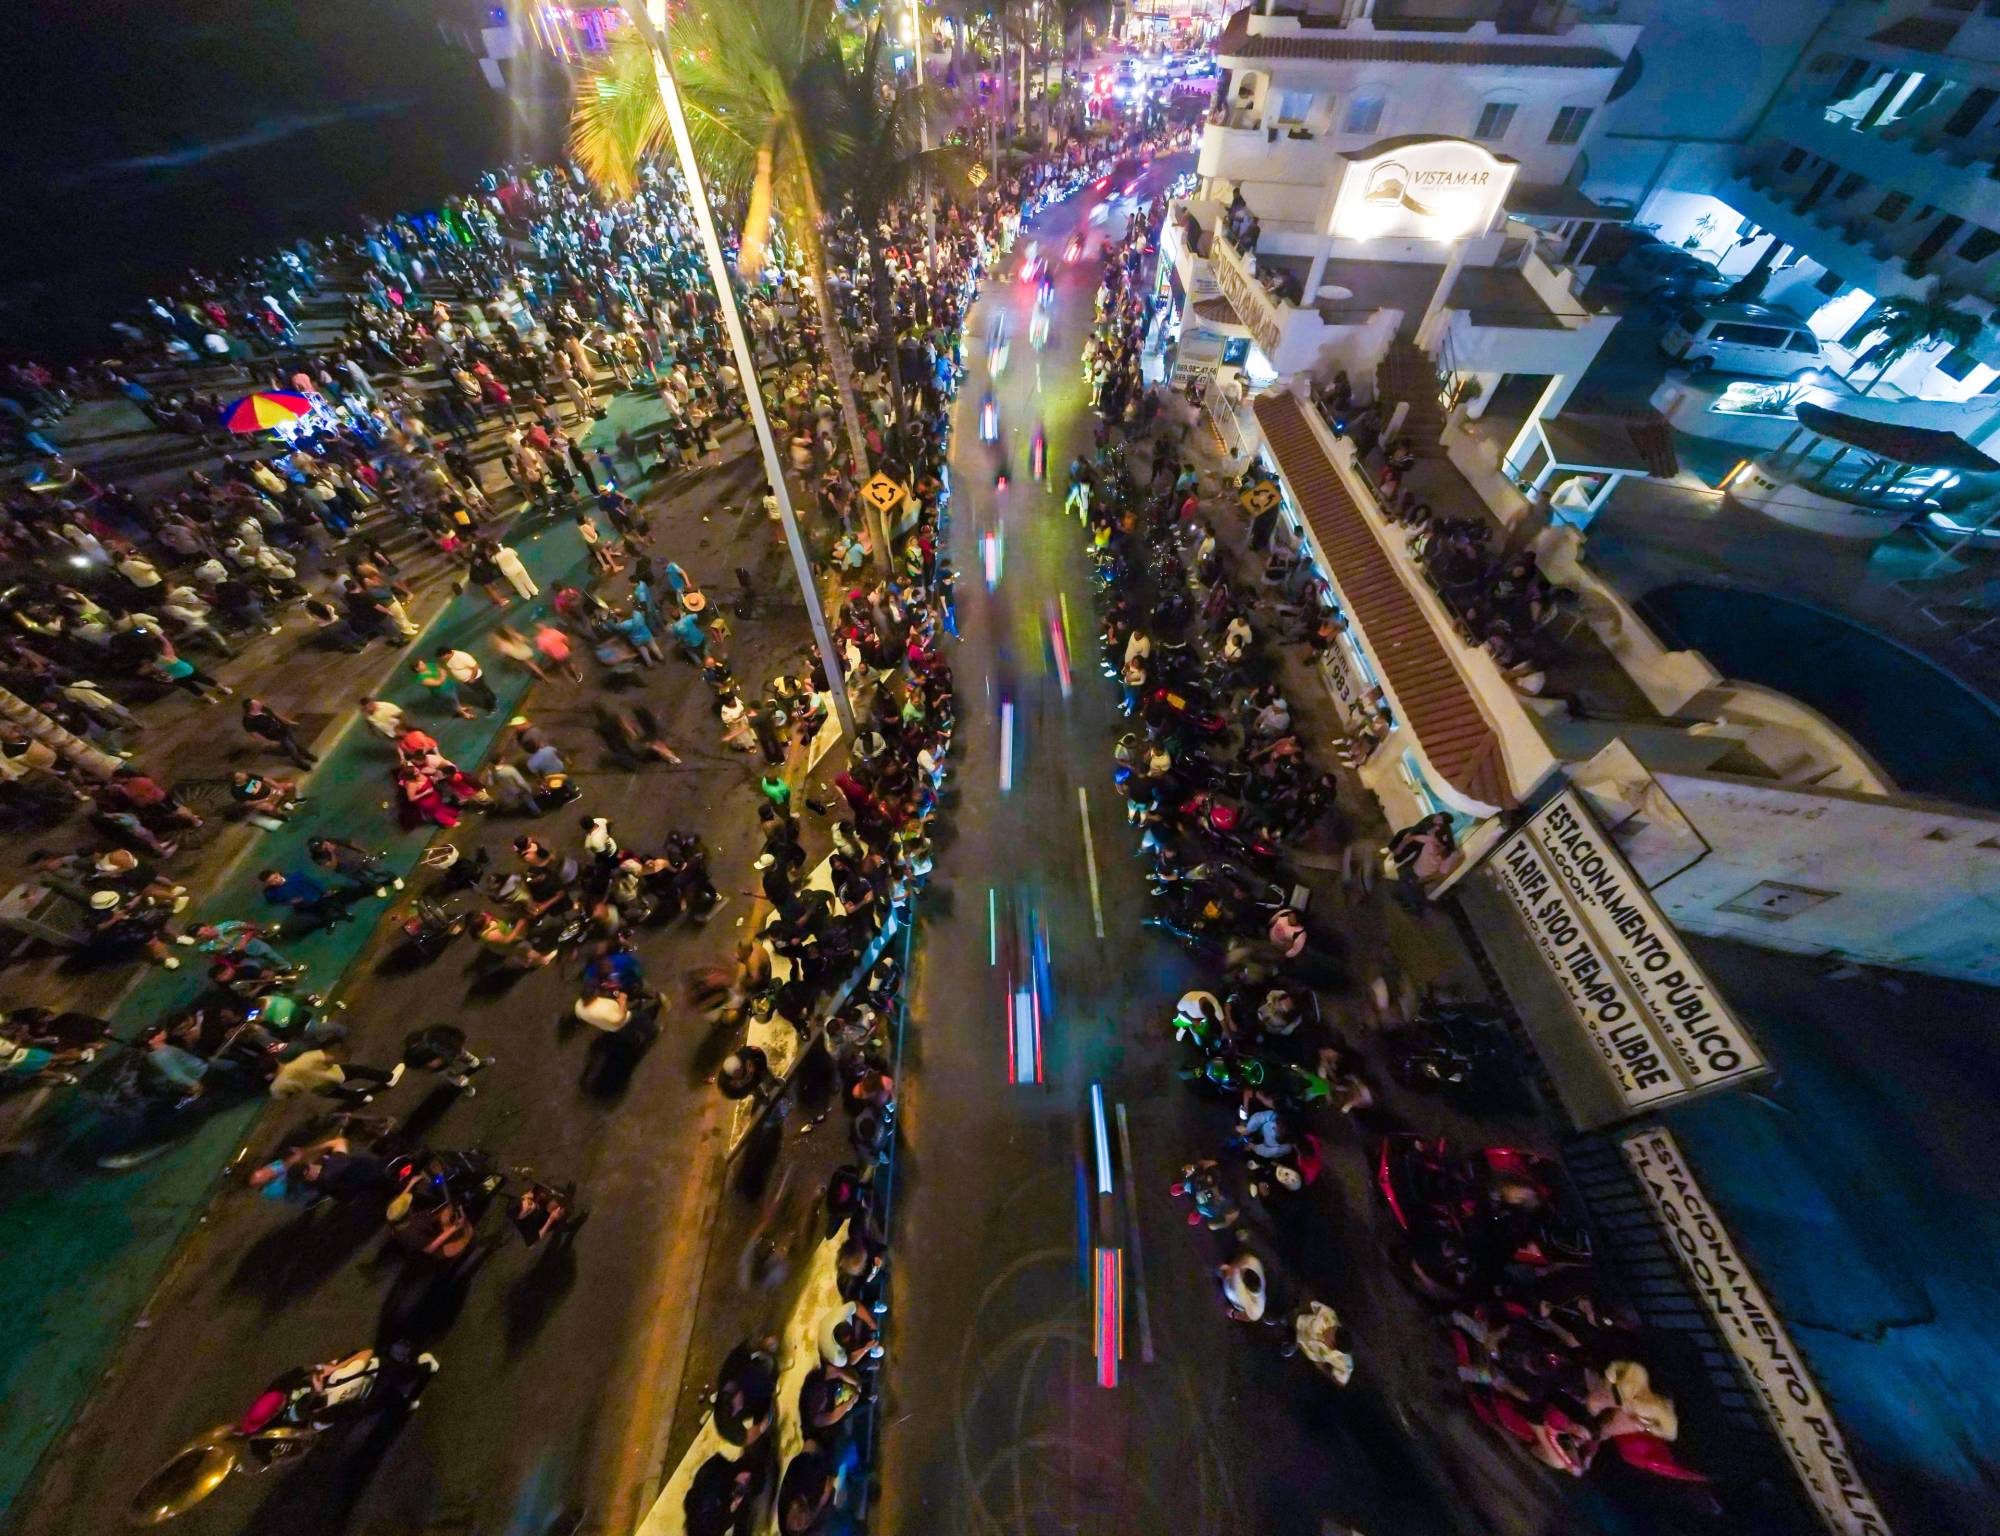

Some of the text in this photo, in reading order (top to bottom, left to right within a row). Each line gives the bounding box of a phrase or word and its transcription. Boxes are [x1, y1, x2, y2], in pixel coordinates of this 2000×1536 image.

[1414, 170, 1490, 185] VISTAMAR
[1332, 665, 1350, 702] 983
[1500, 869, 1540, 936] HORARIO:
[1560, 976, 1580, 1001] AM
[1577, 1004, 1588, 1017] A
[1610, 1063, 1632, 1092] PM
[1504, 839, 1670, 1090] TARIFA $100 TIEMPO LIBRE
[1545, 803, 1741, 1072] ESTACIONAMIENTO PÚBLICO
[1617, 954, 1650, 997] AV.DEL
[1647, 1000, 1673, 1034] MAR
[1671, 1037, 1702, 1076] 2628
[1649, 1137, 1810, 1407] ESTACIONAMIENTO
